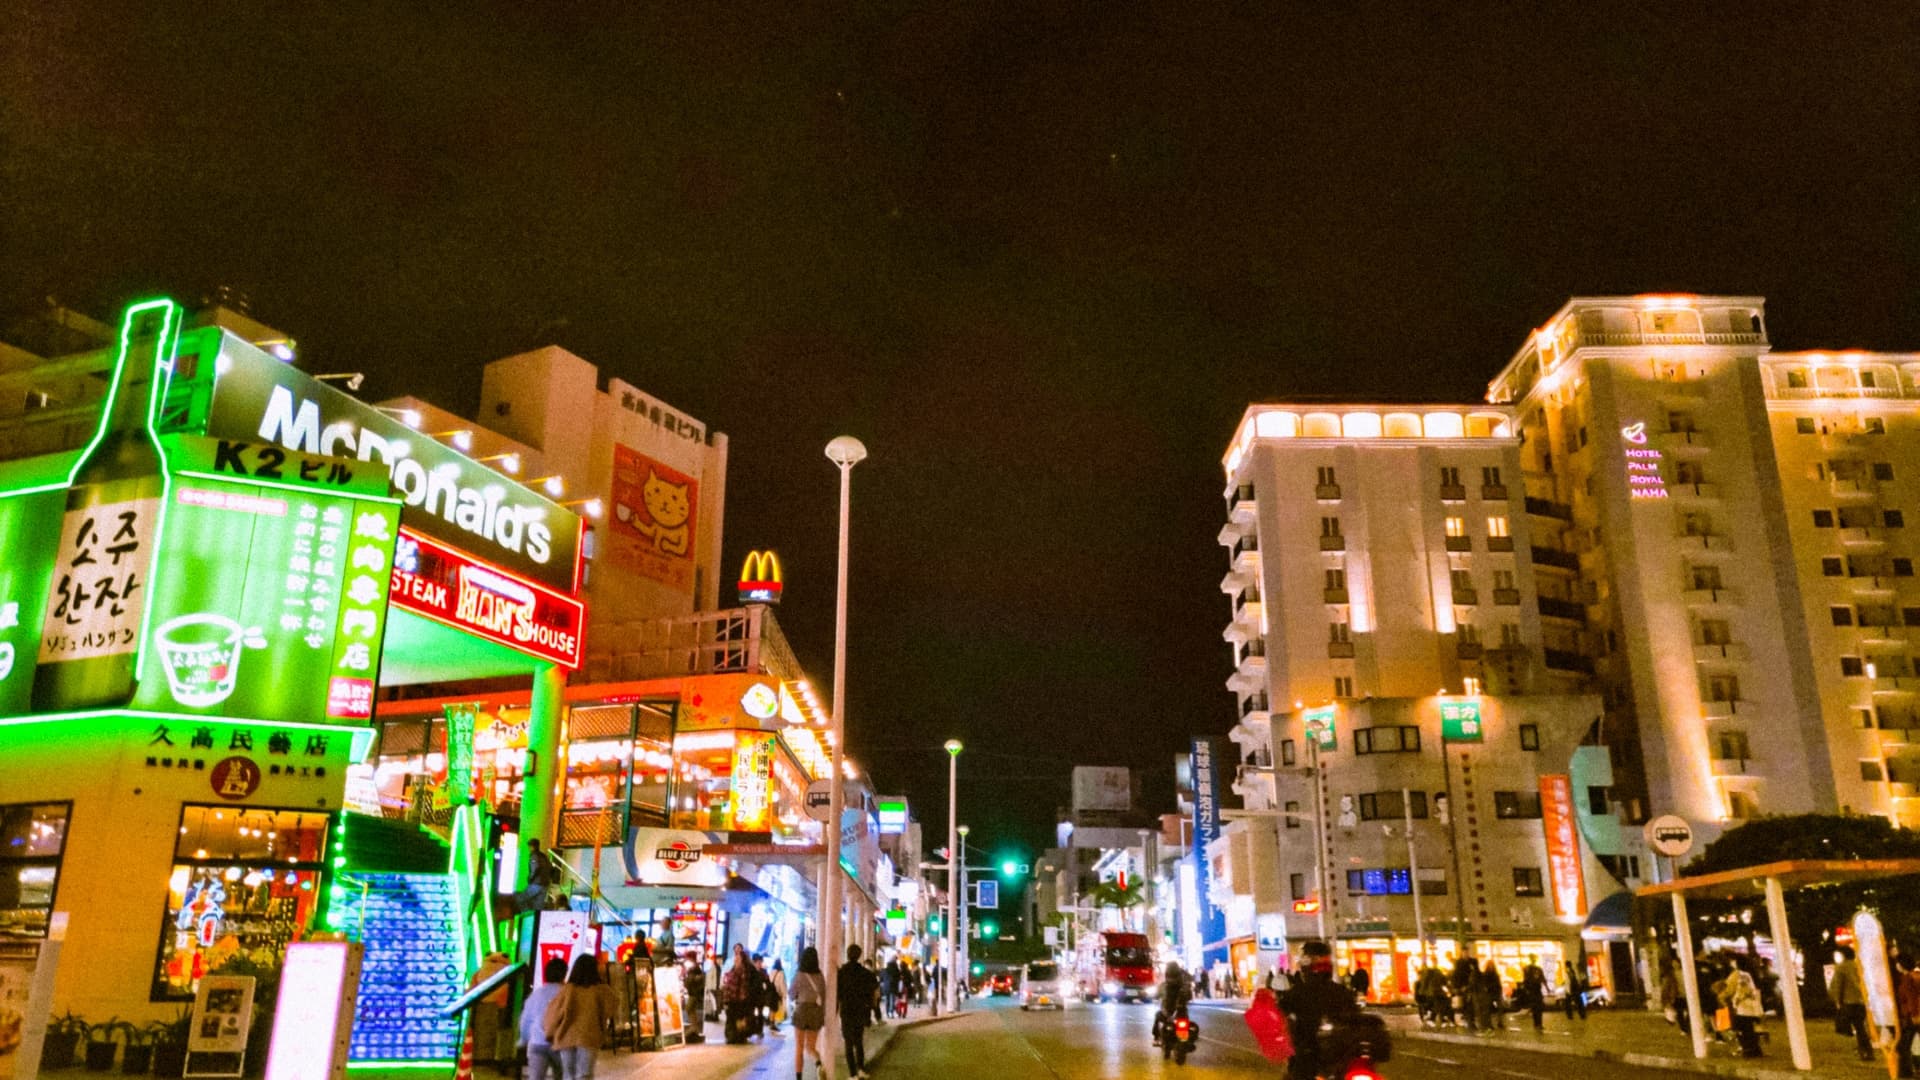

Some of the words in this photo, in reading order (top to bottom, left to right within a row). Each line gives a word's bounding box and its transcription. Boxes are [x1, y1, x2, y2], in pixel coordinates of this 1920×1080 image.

[214, 440, 286, 480] K2
[300, 459, 352, 485] ビル
[1625, 449, 1662, 458] HOTEL
[1628, 462, 1657, 471] PALM
[1630, 475, 1664, 484] ROYAL
[1632, 488, 1668, 498] NAHA
[72, 511, 139, 567] 소주
[54, 573, 141, 625] 한잔
[339, 511, 391, 671] 焼肉専門店
[391, 568, 447, 610] STEAK
[530, 622, 576, 656] HOUSE
[149, 724, 330, 756] 久高民藝店
[658, 849, 678, 860] BLUE
[680, 850, 699, 861] SEAL
